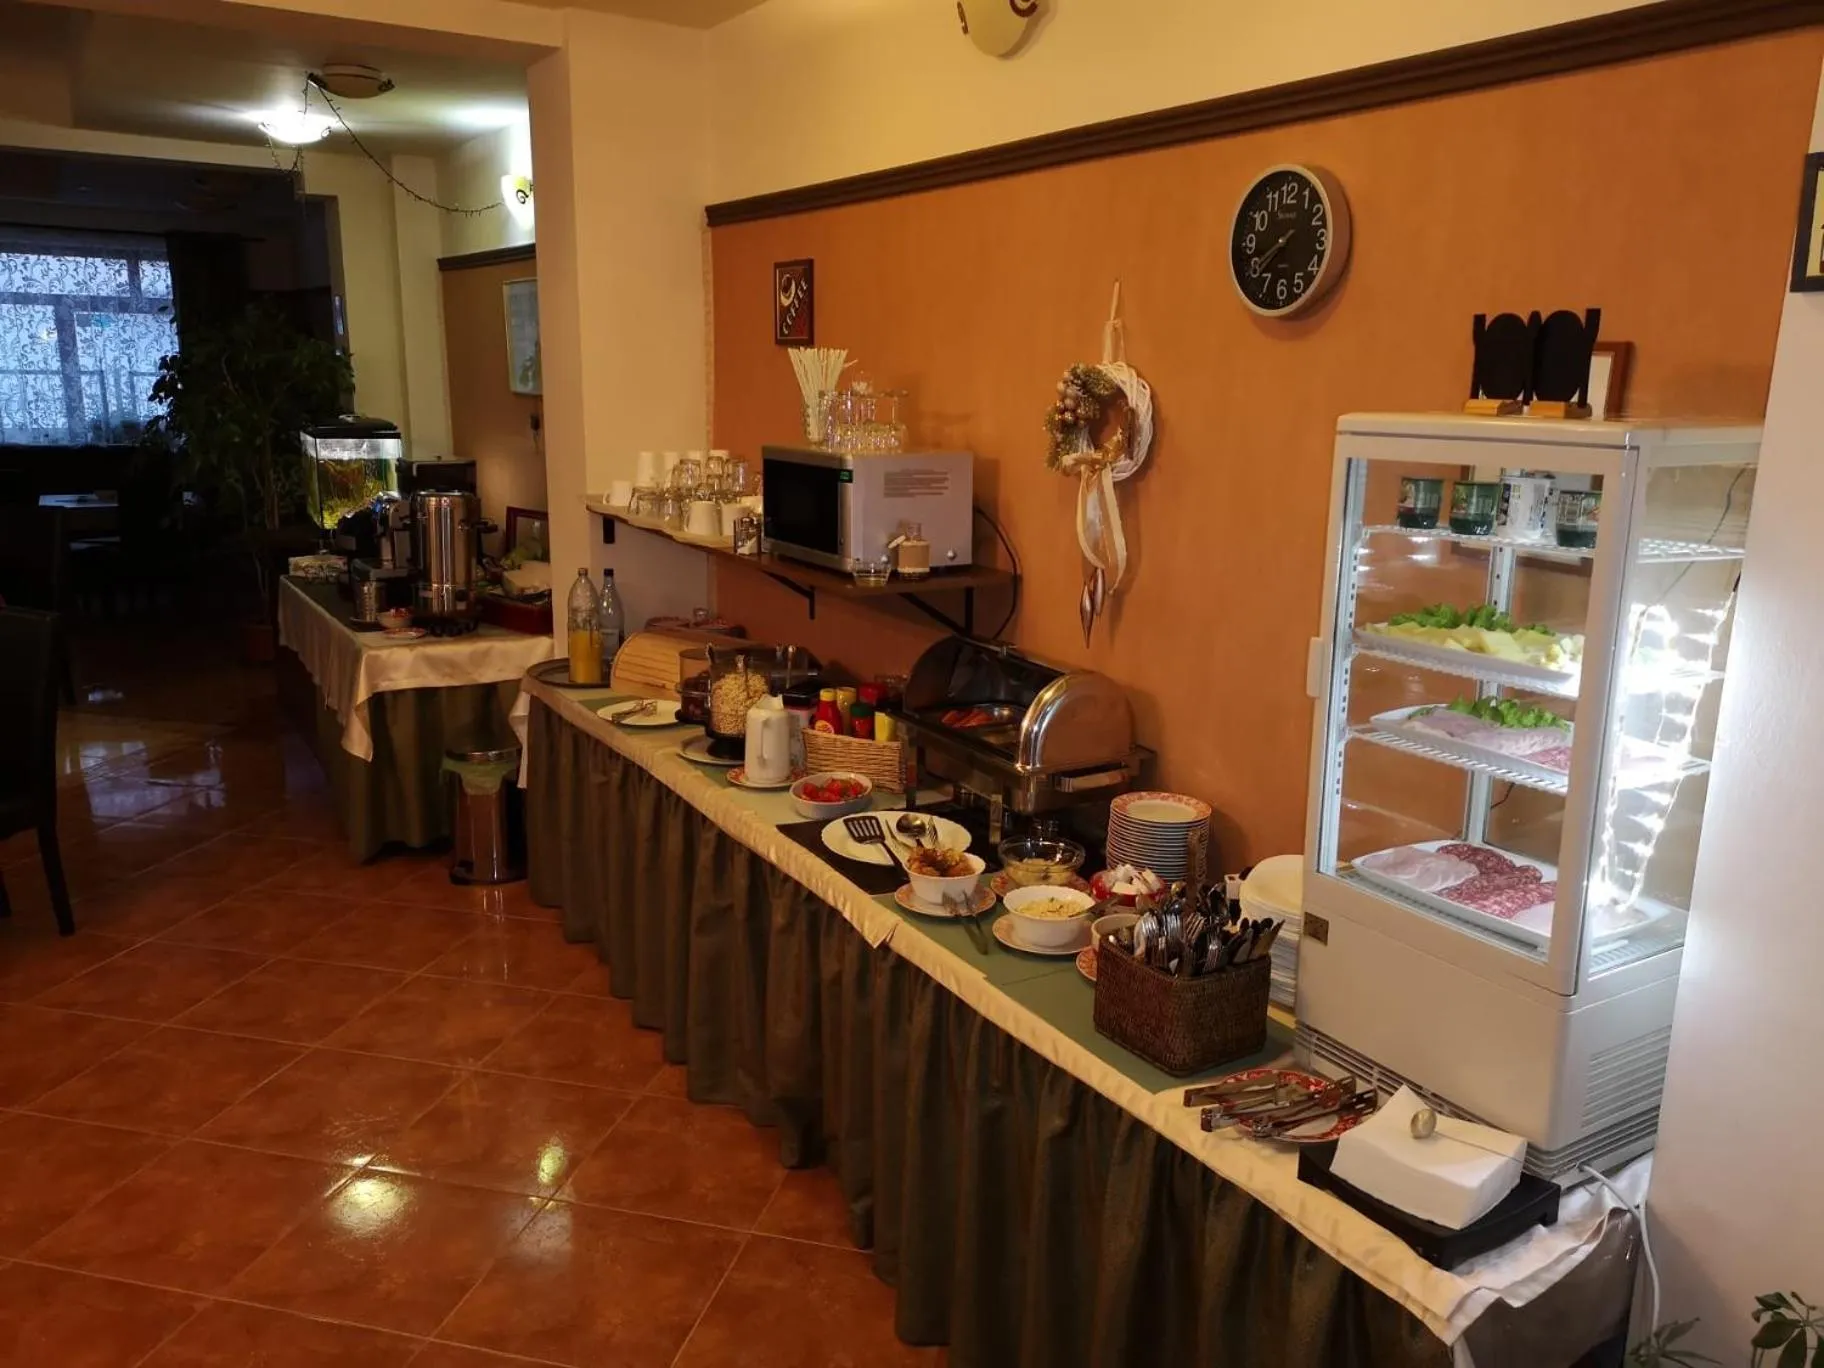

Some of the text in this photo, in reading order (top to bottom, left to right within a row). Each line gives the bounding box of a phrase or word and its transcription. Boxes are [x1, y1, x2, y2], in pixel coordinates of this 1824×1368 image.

[1266, 190, 1279, 211] 11
[1281, 182, 1298, 204] 12
[1303, 188, 1309, 210] 1
[1252, 210, 1268, 231] 10
[1312, 204, 1324, 225] 2
[1246, 233, 1256, 254] 9
[1316, 229, 1327, 250] 3
[1251, 257, 1260, 277] 8
[1308, 254, 1319, 275] 4
[1262, 273, 1271, 293] 7
[1277, 279, 1287, 300] 6
[1293, 273, 1304, 293] 5
